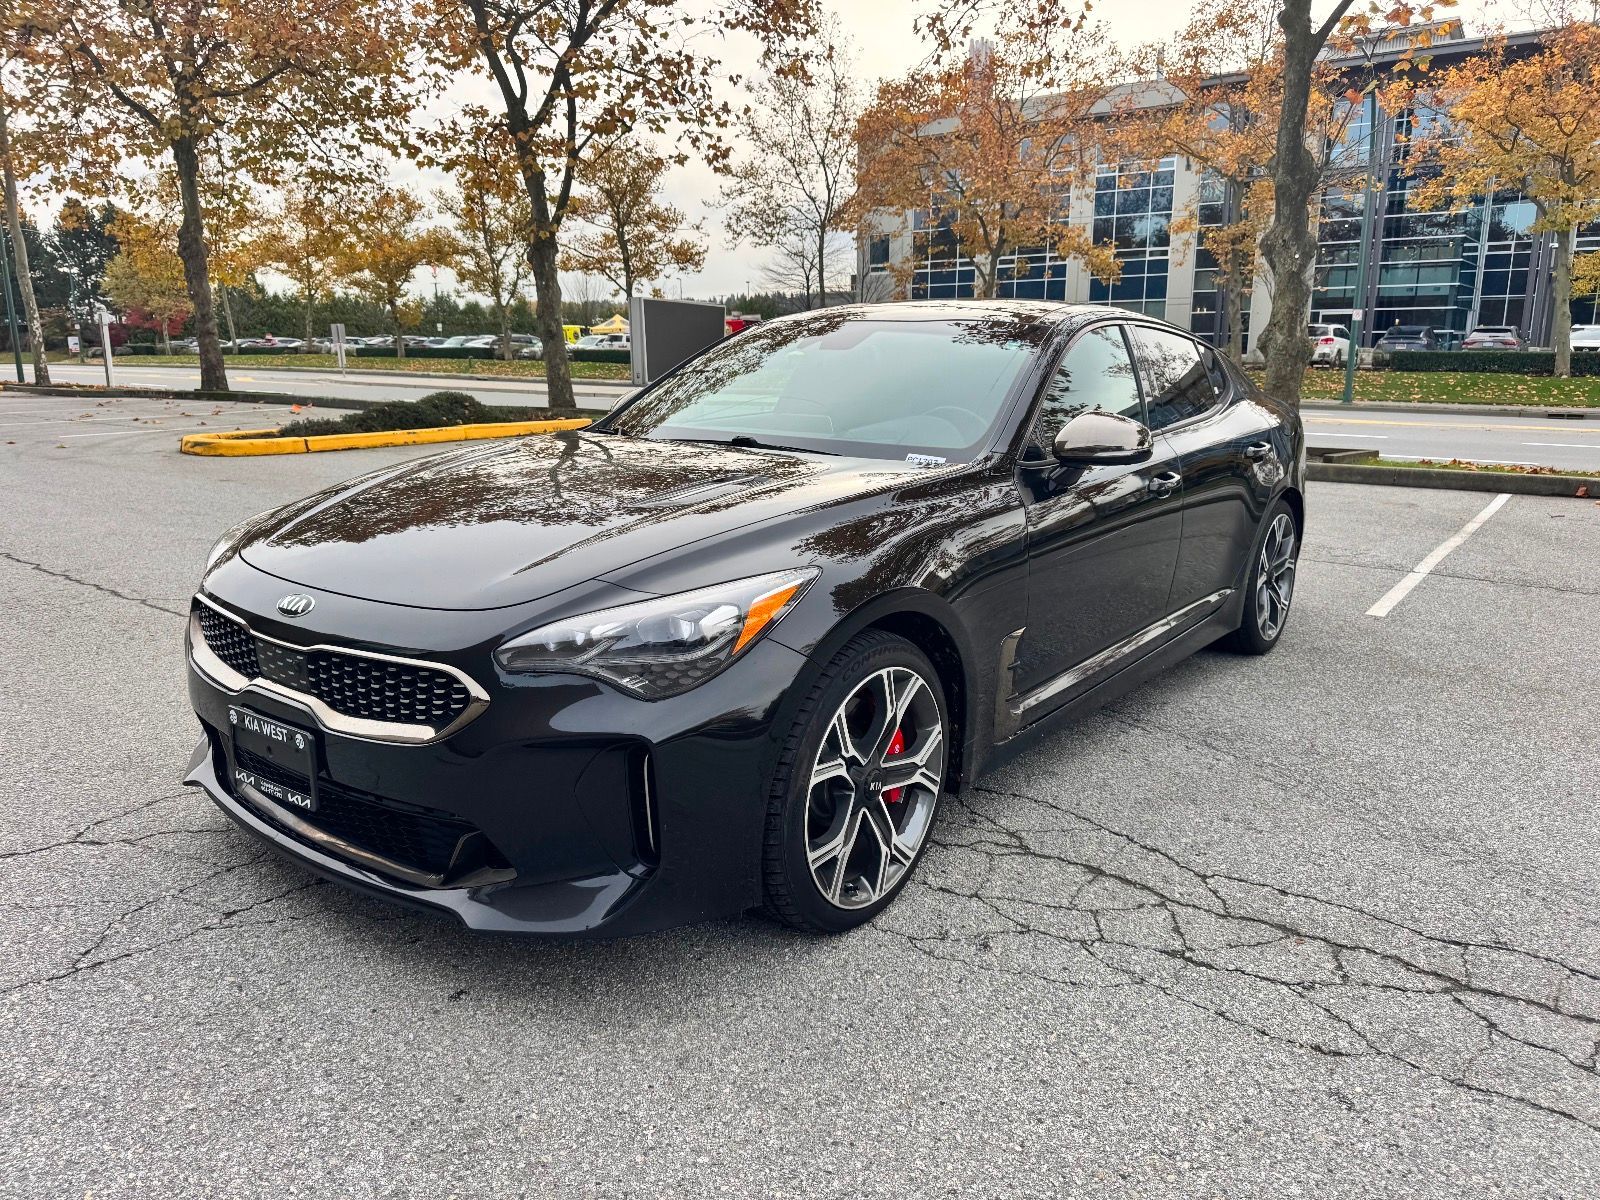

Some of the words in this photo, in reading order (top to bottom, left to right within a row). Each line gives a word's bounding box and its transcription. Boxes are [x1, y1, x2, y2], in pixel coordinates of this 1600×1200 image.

[279, 595, 308, 614] KIA
[244, 714, 261, 733] KIA
[261, 720, 288, 743] WEST
[235, 769, 255, 786] KIA
[869, 781, 882, 791] KIA
[287, 792, 311, 809] KIA
